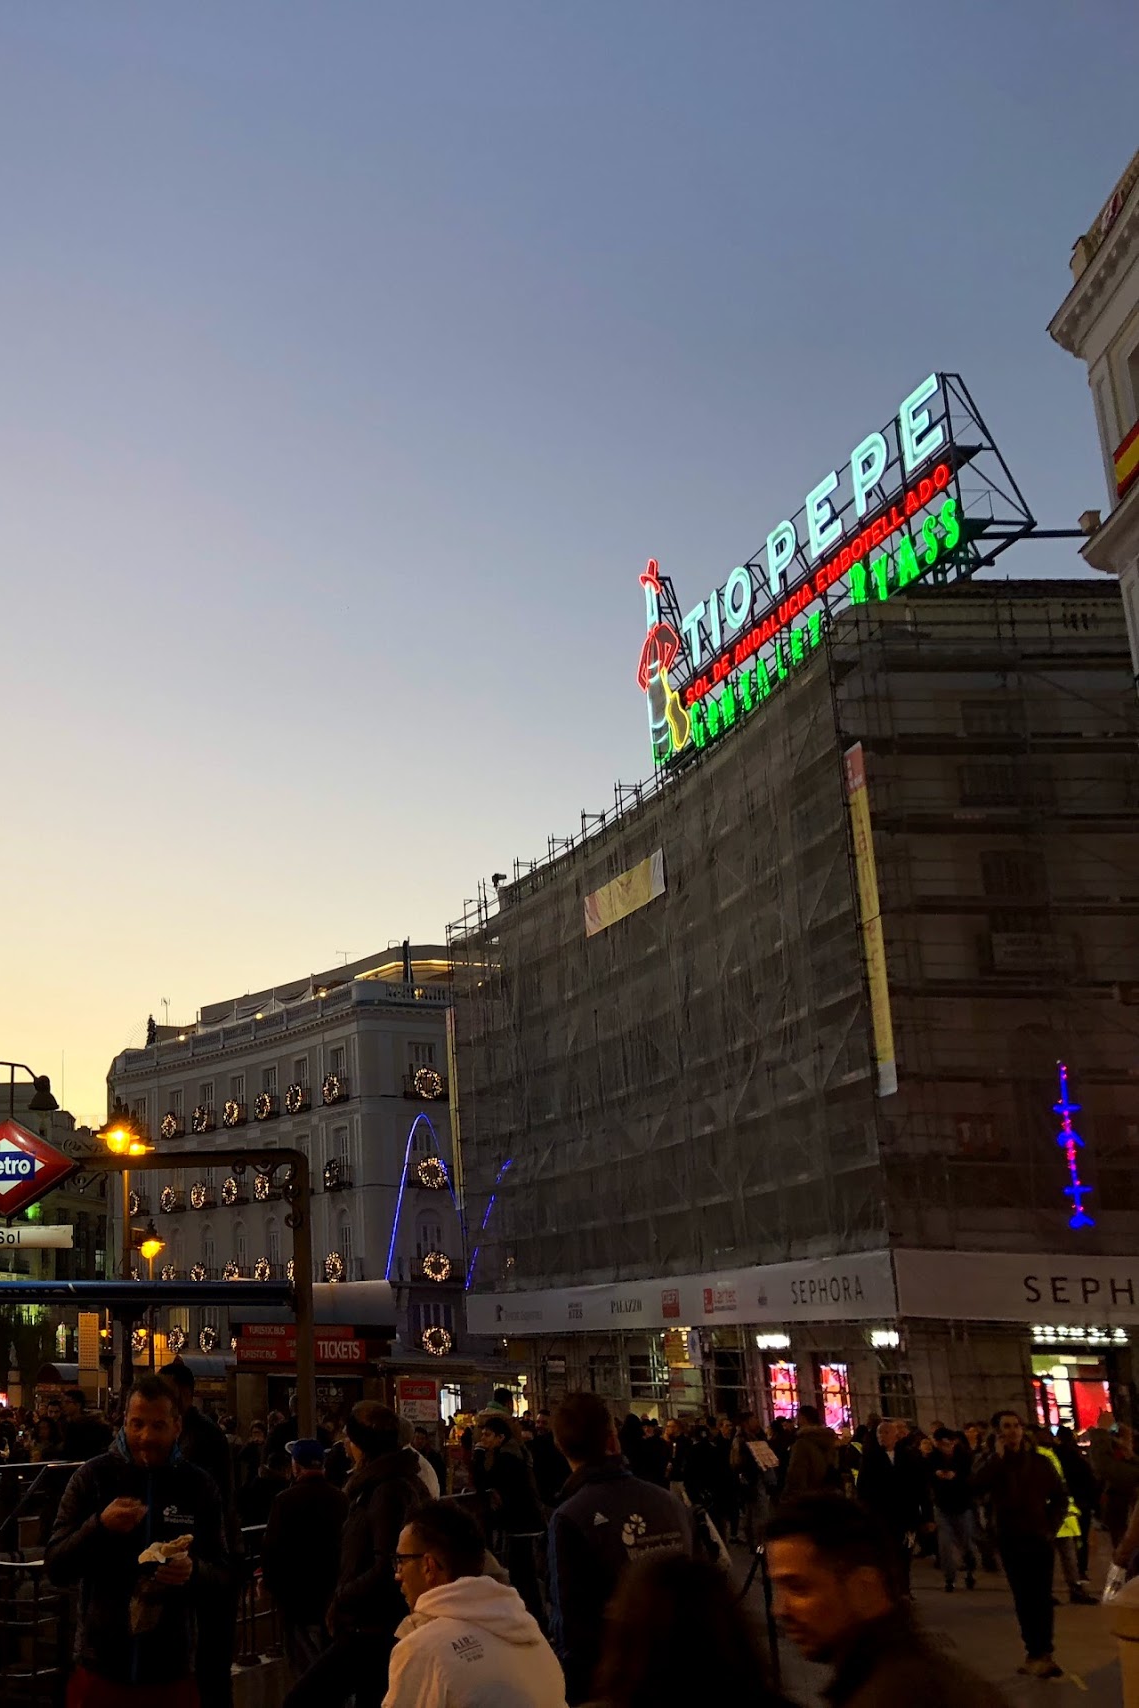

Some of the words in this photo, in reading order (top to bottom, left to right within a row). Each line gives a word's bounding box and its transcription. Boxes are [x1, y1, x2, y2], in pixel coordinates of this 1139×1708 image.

[682, 566, 753, 668] TIO
[766, 372, 945, 596] PEPE
[686, 675, 712, 706] SOL
[713, 653, 731, 682] DE
[735, 584, 813, 665] ANDALUCIA
[816, 464, 949, 592] EMBOTELLADO
[791, 1275, 864, 1305] SEPHORA
[1024, 1276, 1134, 1305] SEPH
[610, 1299, 643, 1314] PALAZZO
[274, 1326, 286, 1335] BUS
[266, 1349, 277, 1359] BUS
[317, 1340, 361, 1360] TICKETS
